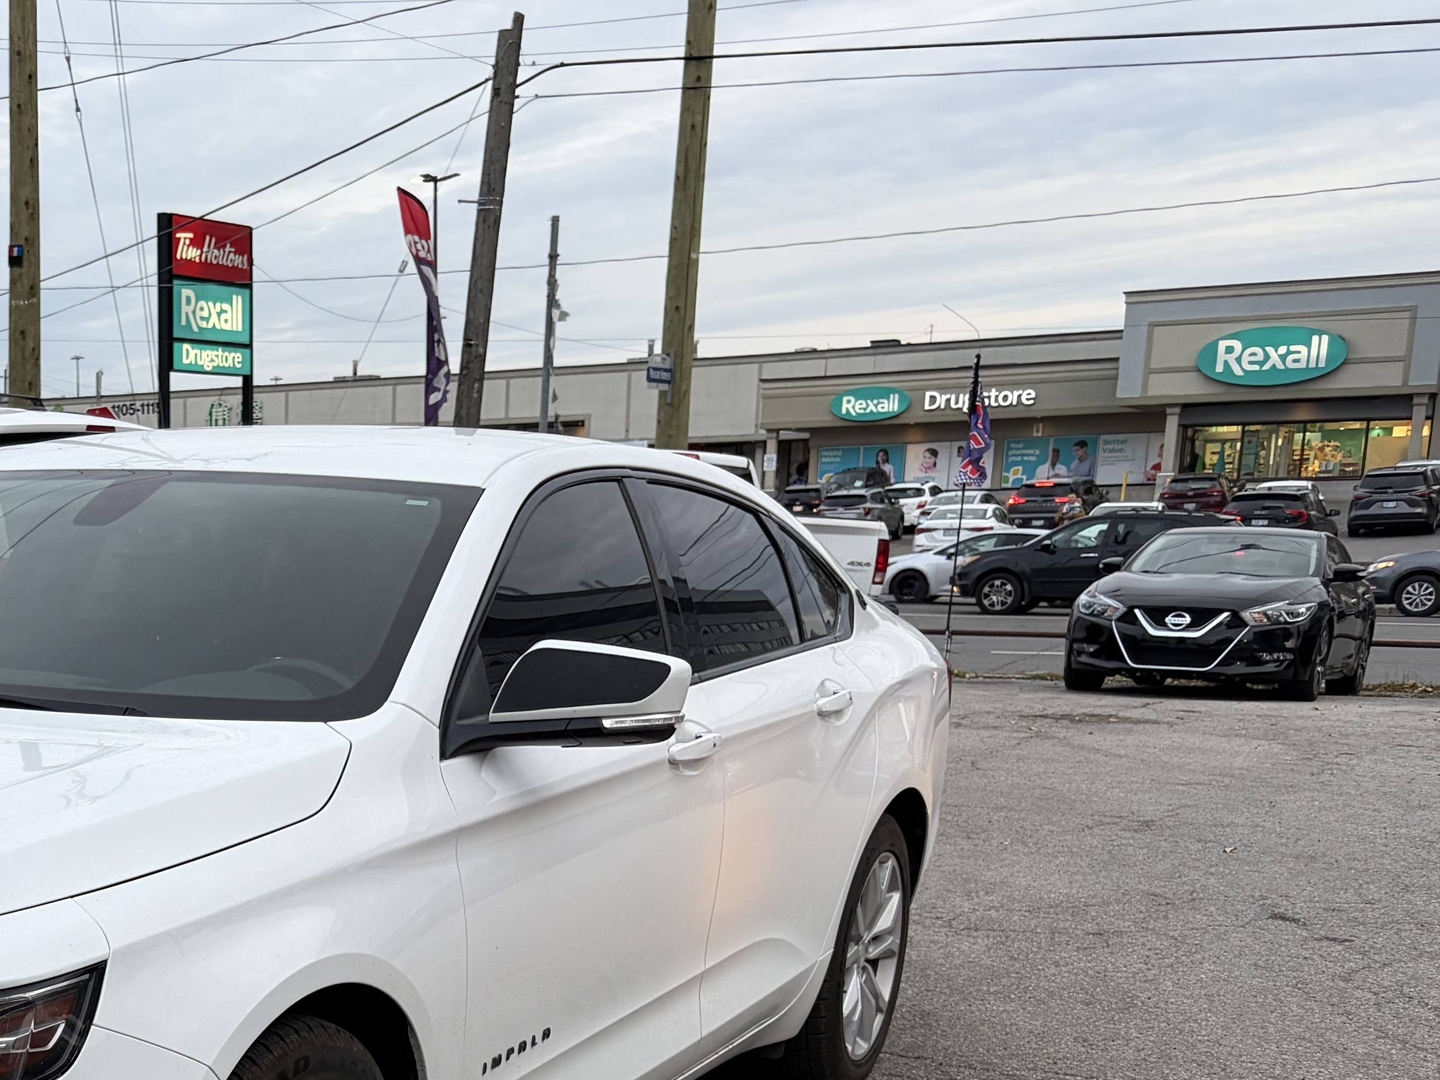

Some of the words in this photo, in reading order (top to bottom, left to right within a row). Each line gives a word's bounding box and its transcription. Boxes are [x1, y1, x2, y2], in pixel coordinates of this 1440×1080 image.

[175, 233, 201, 263] Tim
[202, 235, 249, 269] Hortons
[180, 288, 243, 333] Rexall
[182, 343, 243, 371] Drugstore
[1215, 334, 1329, 376] Rexall
[841, 393, 899, 416] Rexall
[481, 1027, 551, 1077] IMPALA
